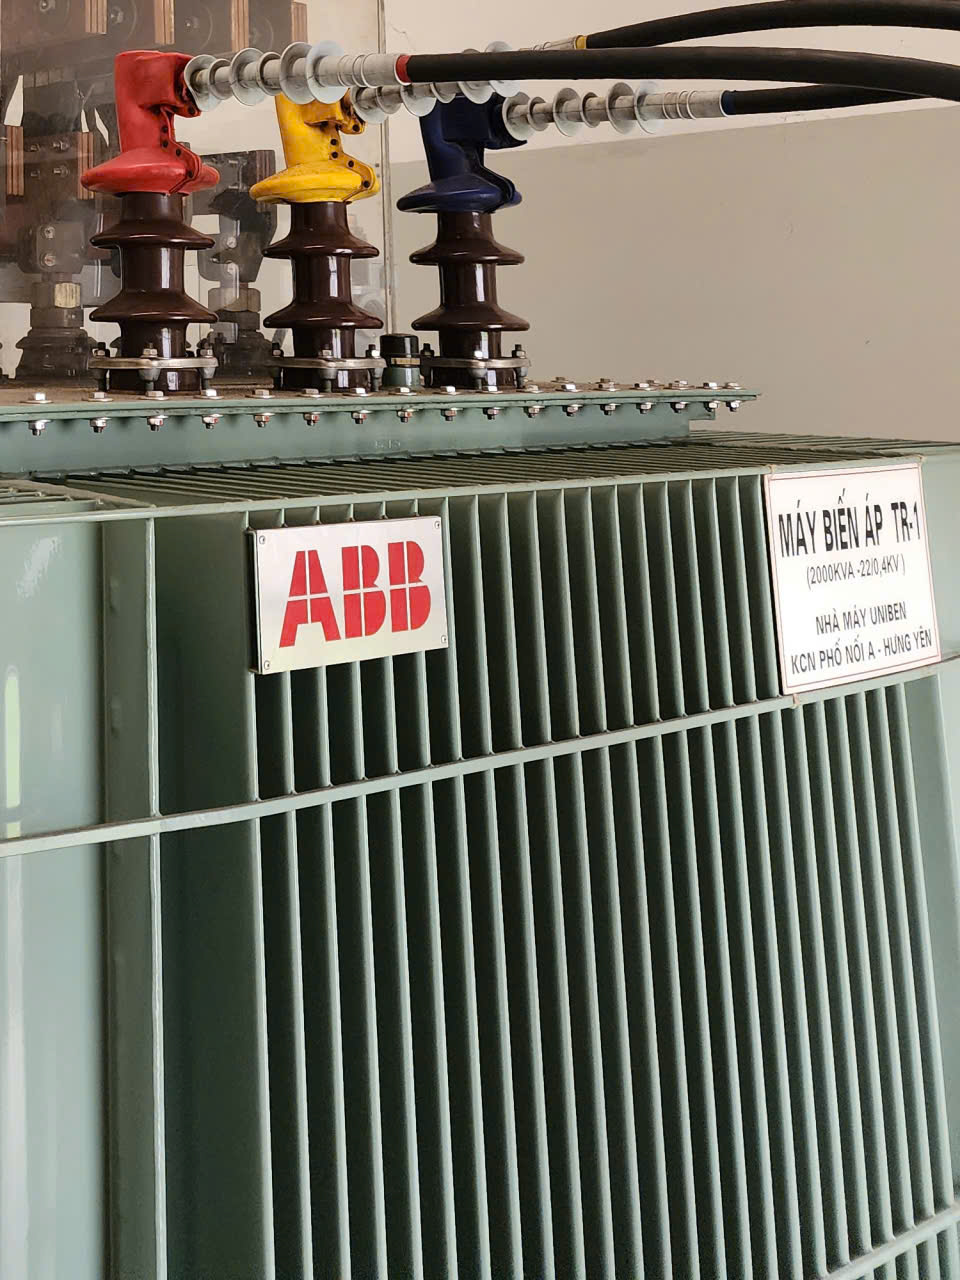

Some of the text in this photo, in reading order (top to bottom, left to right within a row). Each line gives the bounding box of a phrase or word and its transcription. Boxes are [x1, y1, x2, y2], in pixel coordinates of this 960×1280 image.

[778, 488, 921, 558] MÁY BIẾN ÁP TR-1
[279, 541, 431, 648] ABB
[806, 561, 855, 590] (2000KVA
[816, 601, 907, 635] NHÀ MÁY UNIBEN
[791, 652, 816, 675] KCN
[819, 638, 842, 669] PHỐ
[845, 634, 864, 664] NỐI
[868, 641, 875, 662] A
[884, 633, 912, 657] HƯNG
[913, 625, 932, 649] YÊN
